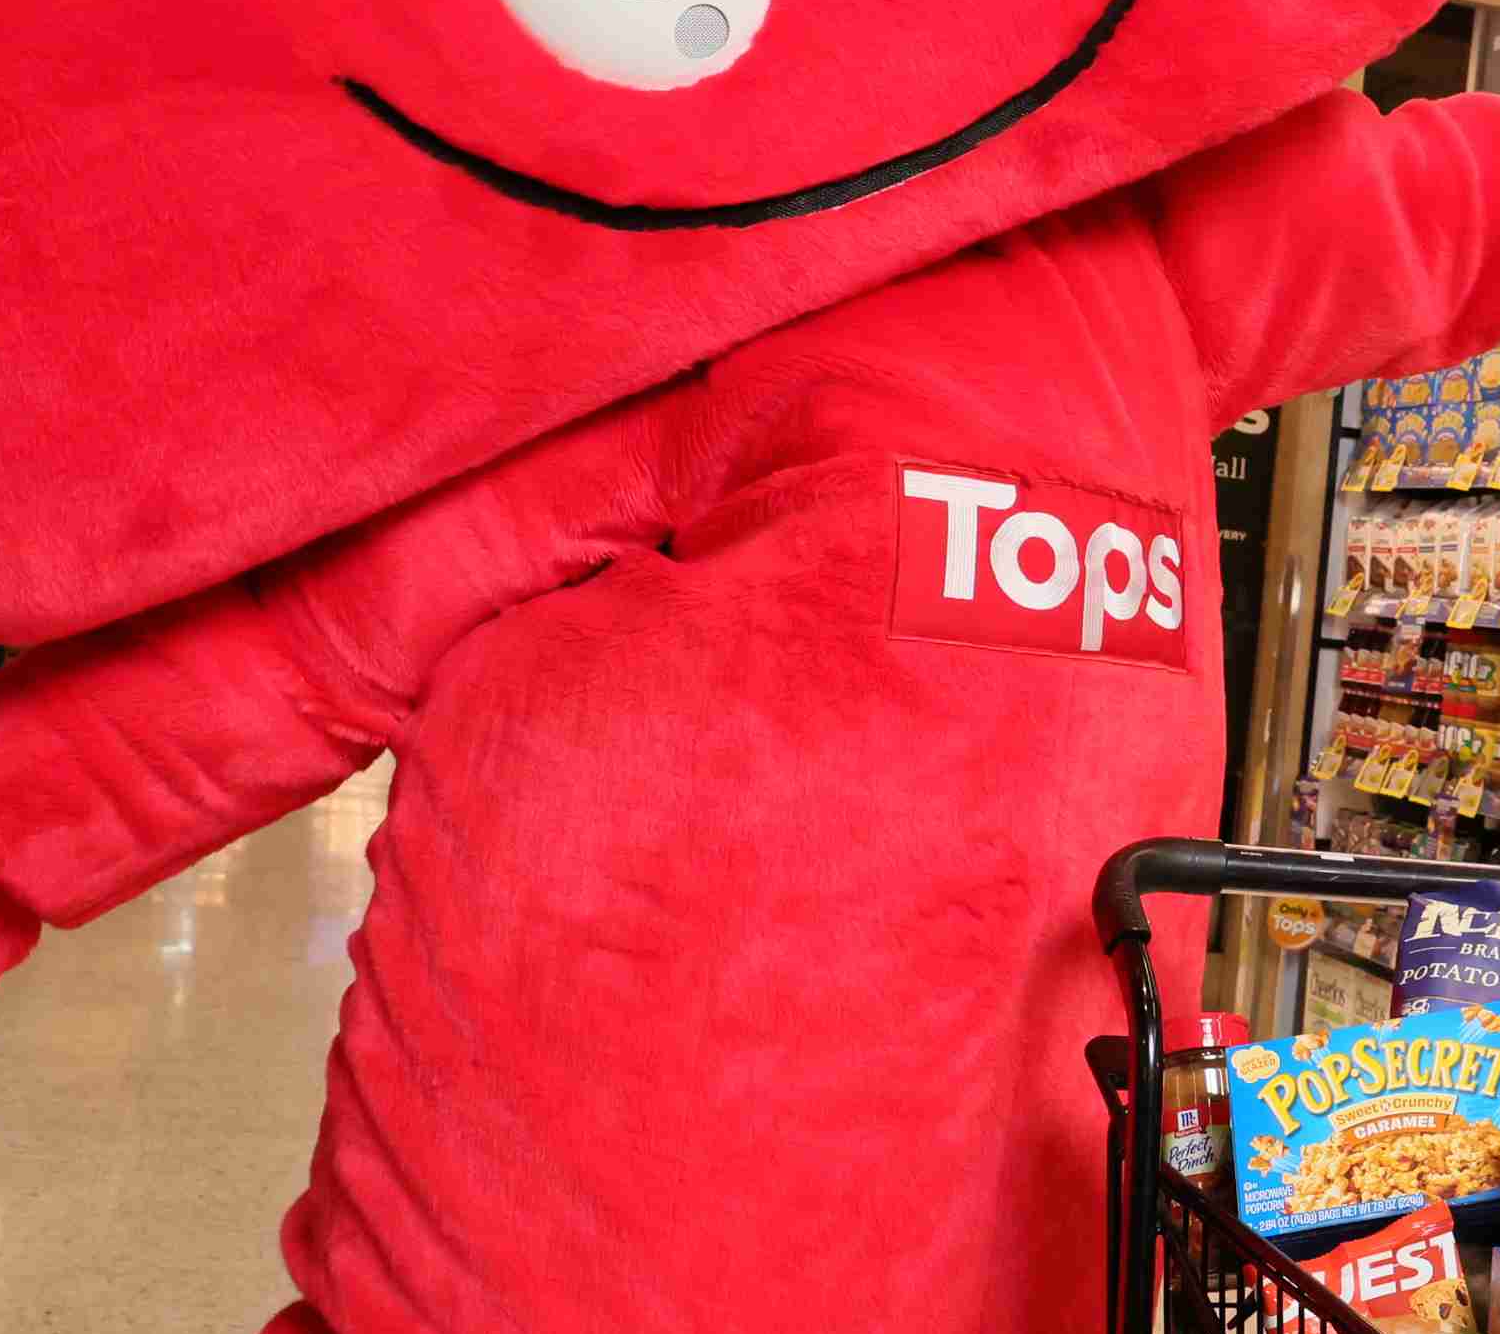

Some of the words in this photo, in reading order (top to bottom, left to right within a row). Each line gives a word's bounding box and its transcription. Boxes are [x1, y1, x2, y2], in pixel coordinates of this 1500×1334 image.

[902, 468, 1182, 652] Tops
[1400, 963, 1500, 987] POTATO
[1335, 1101, 1380, 1127] Sweet
[1392, 1096, 1453, 1115] Crunchy
[1354, 1114, 1437, 1140] CARAMEL
[1244, 1186, 1293, 1201] MICROWAVE
[1244, 1198, 1286, 1215] POPCORN
[1321, 1231, 1460, 1305] UEST
